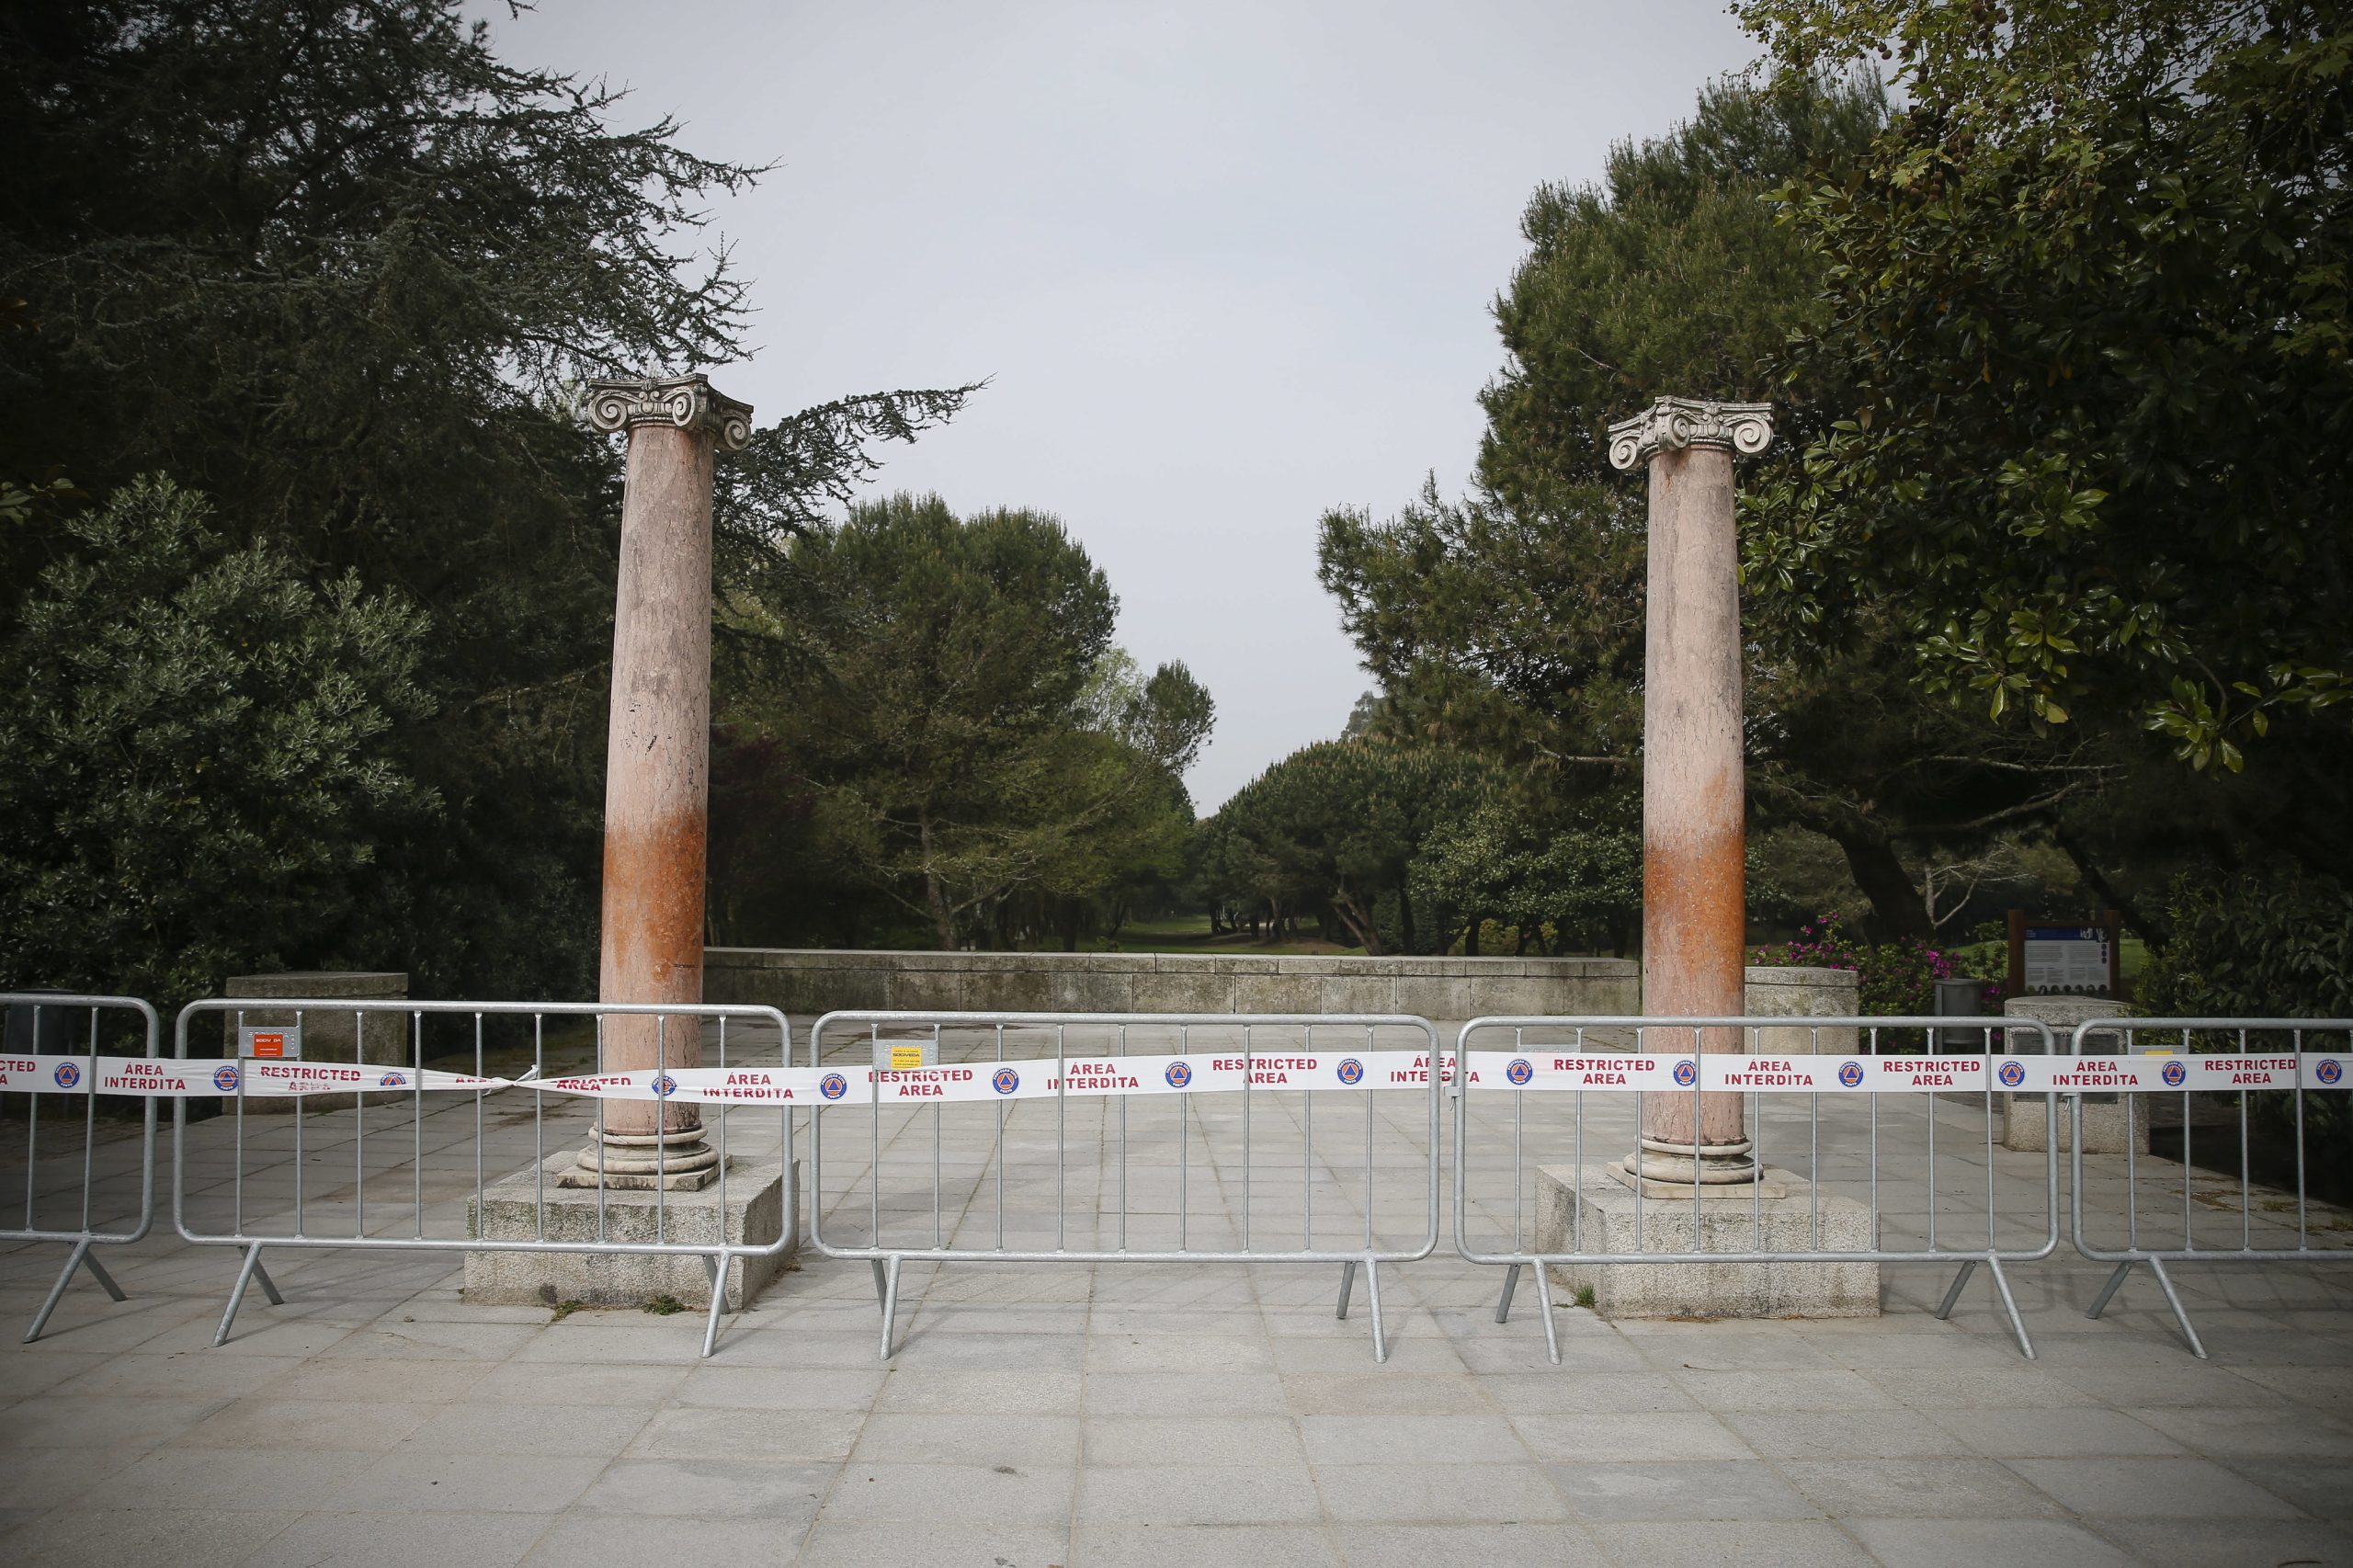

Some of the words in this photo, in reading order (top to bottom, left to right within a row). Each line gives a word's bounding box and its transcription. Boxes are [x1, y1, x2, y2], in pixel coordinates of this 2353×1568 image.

[125, 1062, 163, 1075] ÁREA
[1071, 1062, 1115, 1074] ÁREA
[1212, 1059, 1317, 1071] RESTRICTED
[1553, 1059, 1655, 1071] RESTRICTED
[1750, 1059, 1791, 1072] ÁREA
[1883, 1061, 1981, 1072] RESTRICTED
[2075, 1059, 2118, 1071] ÁREA
[2205, 1060, 2296, 1070] RESTRICTED
[261, 1066, 360, 1081] RESTRICTED
[727, 1072, 771, 1085] ÁREA
[869, 1070, 973, 1083] RESTRICTED
[1584, 1074, 1626, 1085] AREA
[1913, 1074, 1953, 1085] AREA
[2053, 1074, 2138, 1085] INTERDITA
[2232, 1074, 2271, 1084] AREA
[105, 1076, 186, 1090] INTERDITA
[1724, 1074, 1813, 1086] INTERDITA
[703, 1087, 794, 1098] INTERDITA
[900, 1085, 942, 1096] AREA
